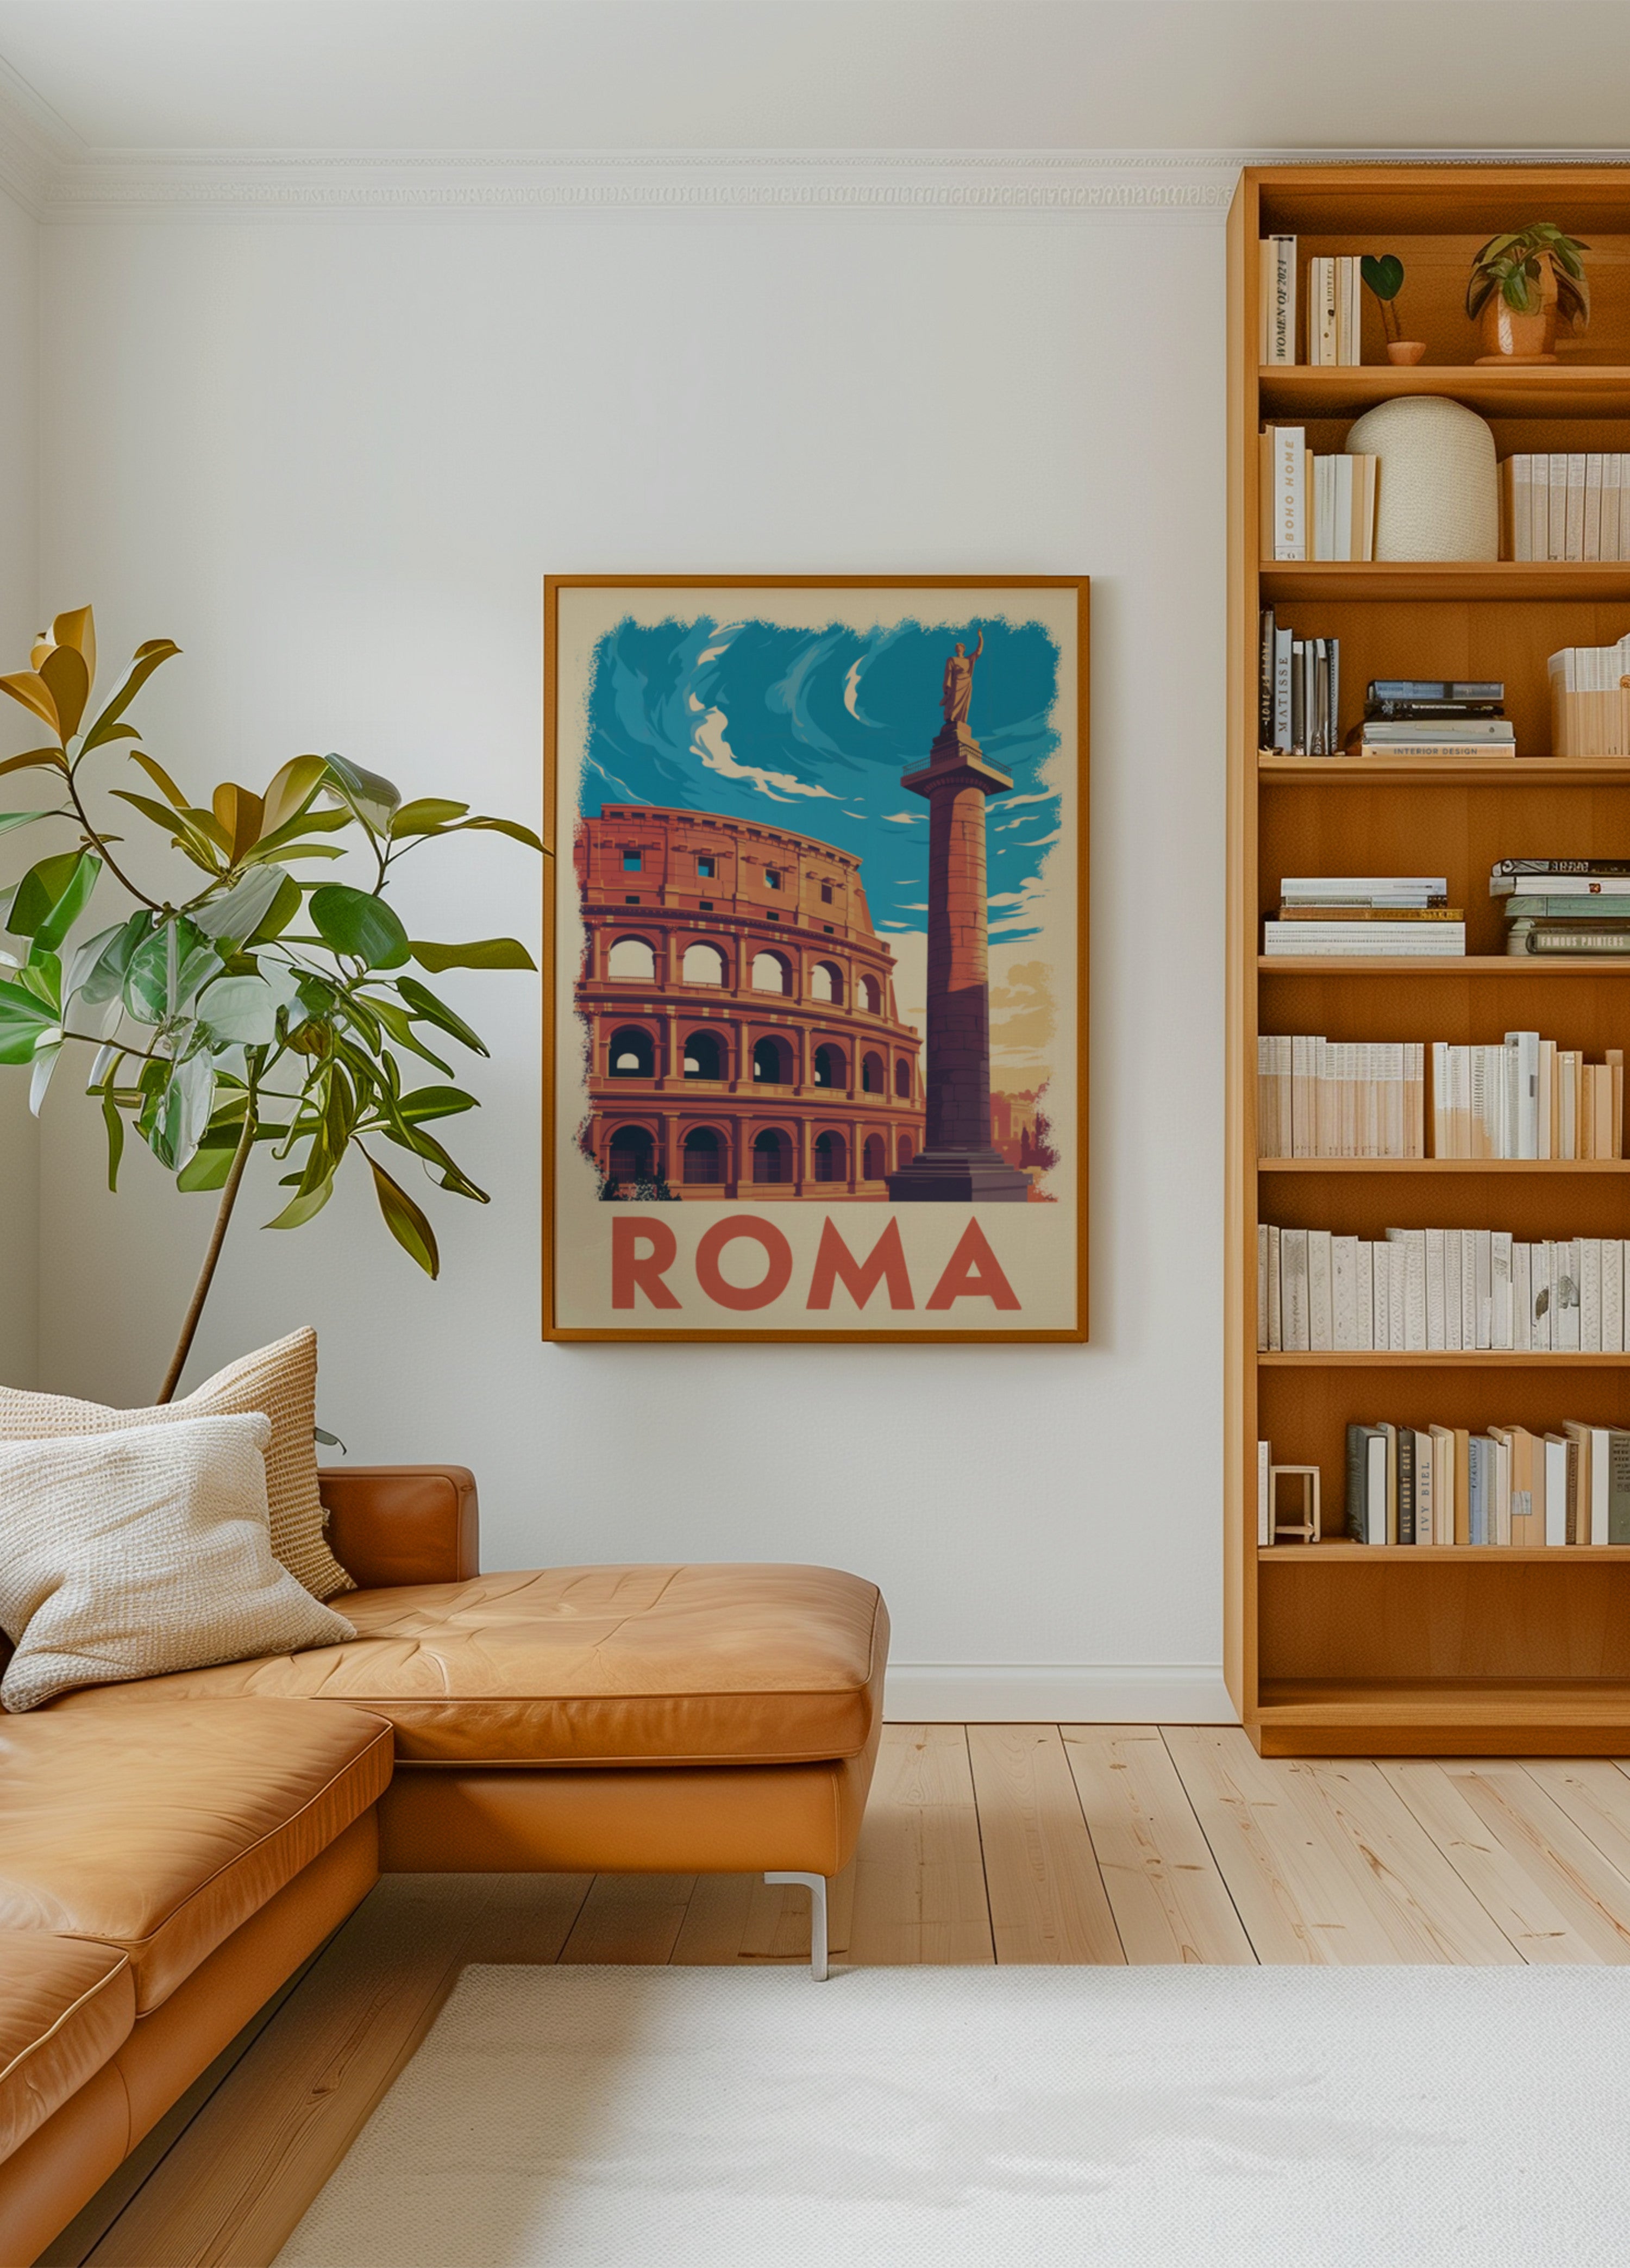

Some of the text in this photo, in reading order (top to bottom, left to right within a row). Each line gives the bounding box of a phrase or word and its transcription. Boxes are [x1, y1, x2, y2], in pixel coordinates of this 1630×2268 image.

[1276, 259, 1287, 358] WOMEN OF 2024
[1284, 440, 1294, 487] HOME
[1284, 495, 1294, 542] BOHO
[1278, 656, 1288, 733] MATISSE
[1541, 936, 1625, 947] FAMOUS PAINTERS
[612, 1214, 1022, 1311] ROMA
[1402, 1444, 1411, 1533] ALL ABOUT CATS
[1421, 1462, 1430, 1532] IVY BIEL
